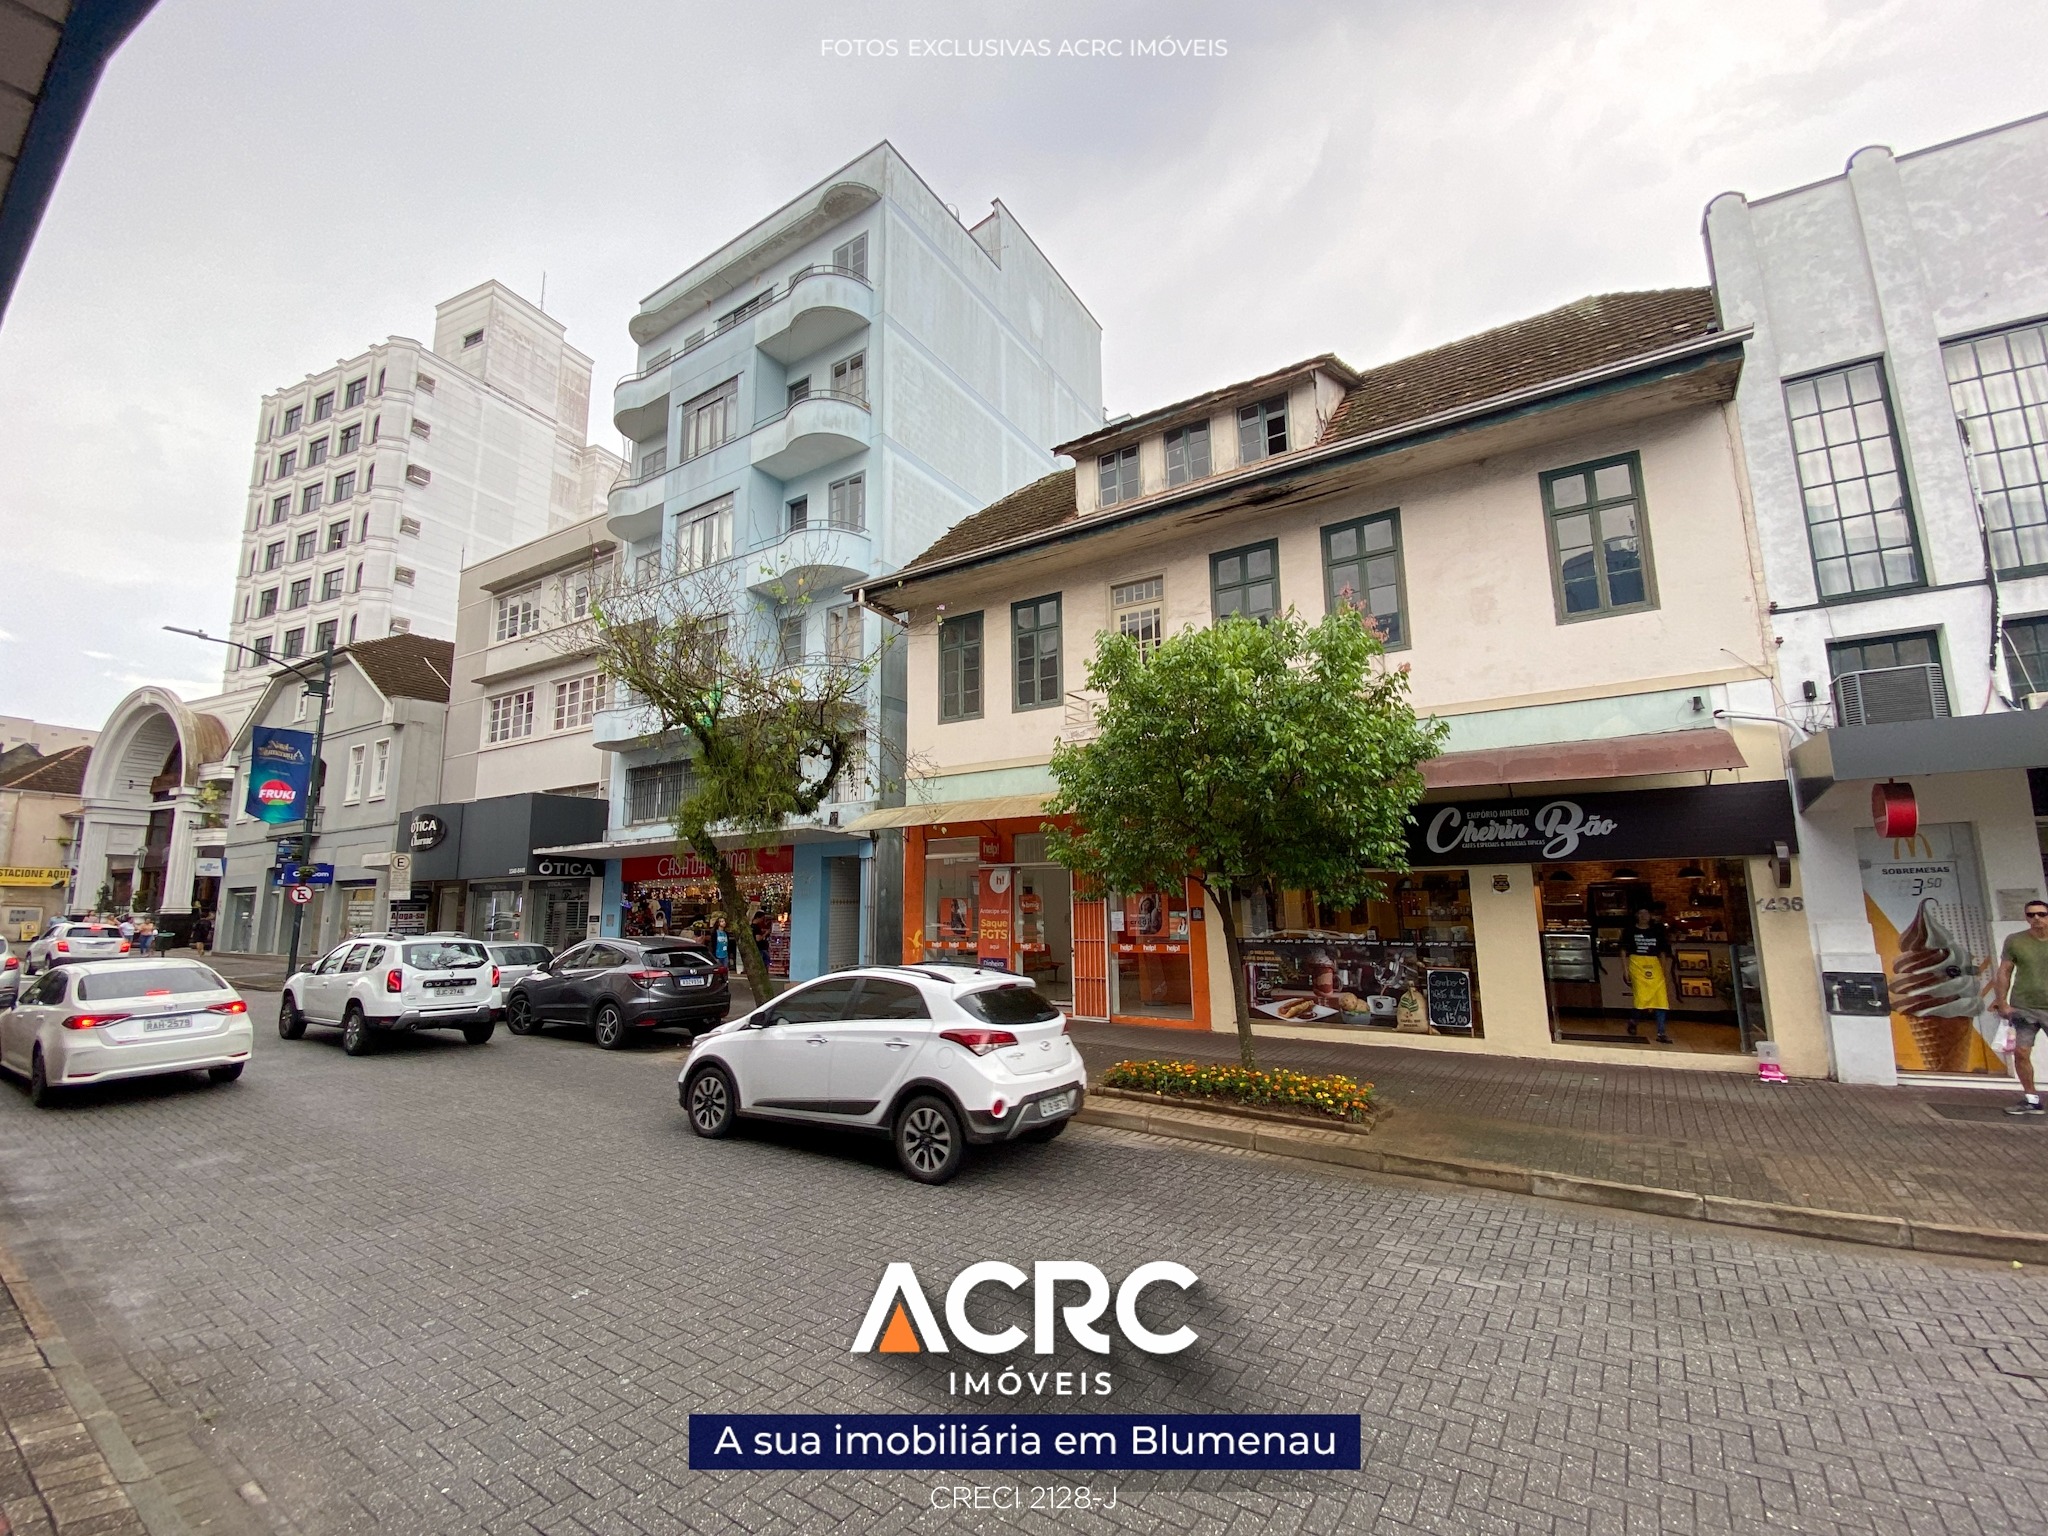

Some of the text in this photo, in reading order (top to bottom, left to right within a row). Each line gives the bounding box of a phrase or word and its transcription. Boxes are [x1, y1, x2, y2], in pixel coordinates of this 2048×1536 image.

[258, 788, 297, 800] FRUKI
[1466, 808, 1530, 819] EMPÓRIO MINEIRO
[1426, 801, 1618, 859] Cheirin Bão
[397, 857, 405, 868] E
[539, 859, 595, 875] ÓTICA
[1881, 866, 1950, 875] SOBREMESAS
[981, 919, 1008, 928] Saque
[980, 929, 1008, 939] FGTS
